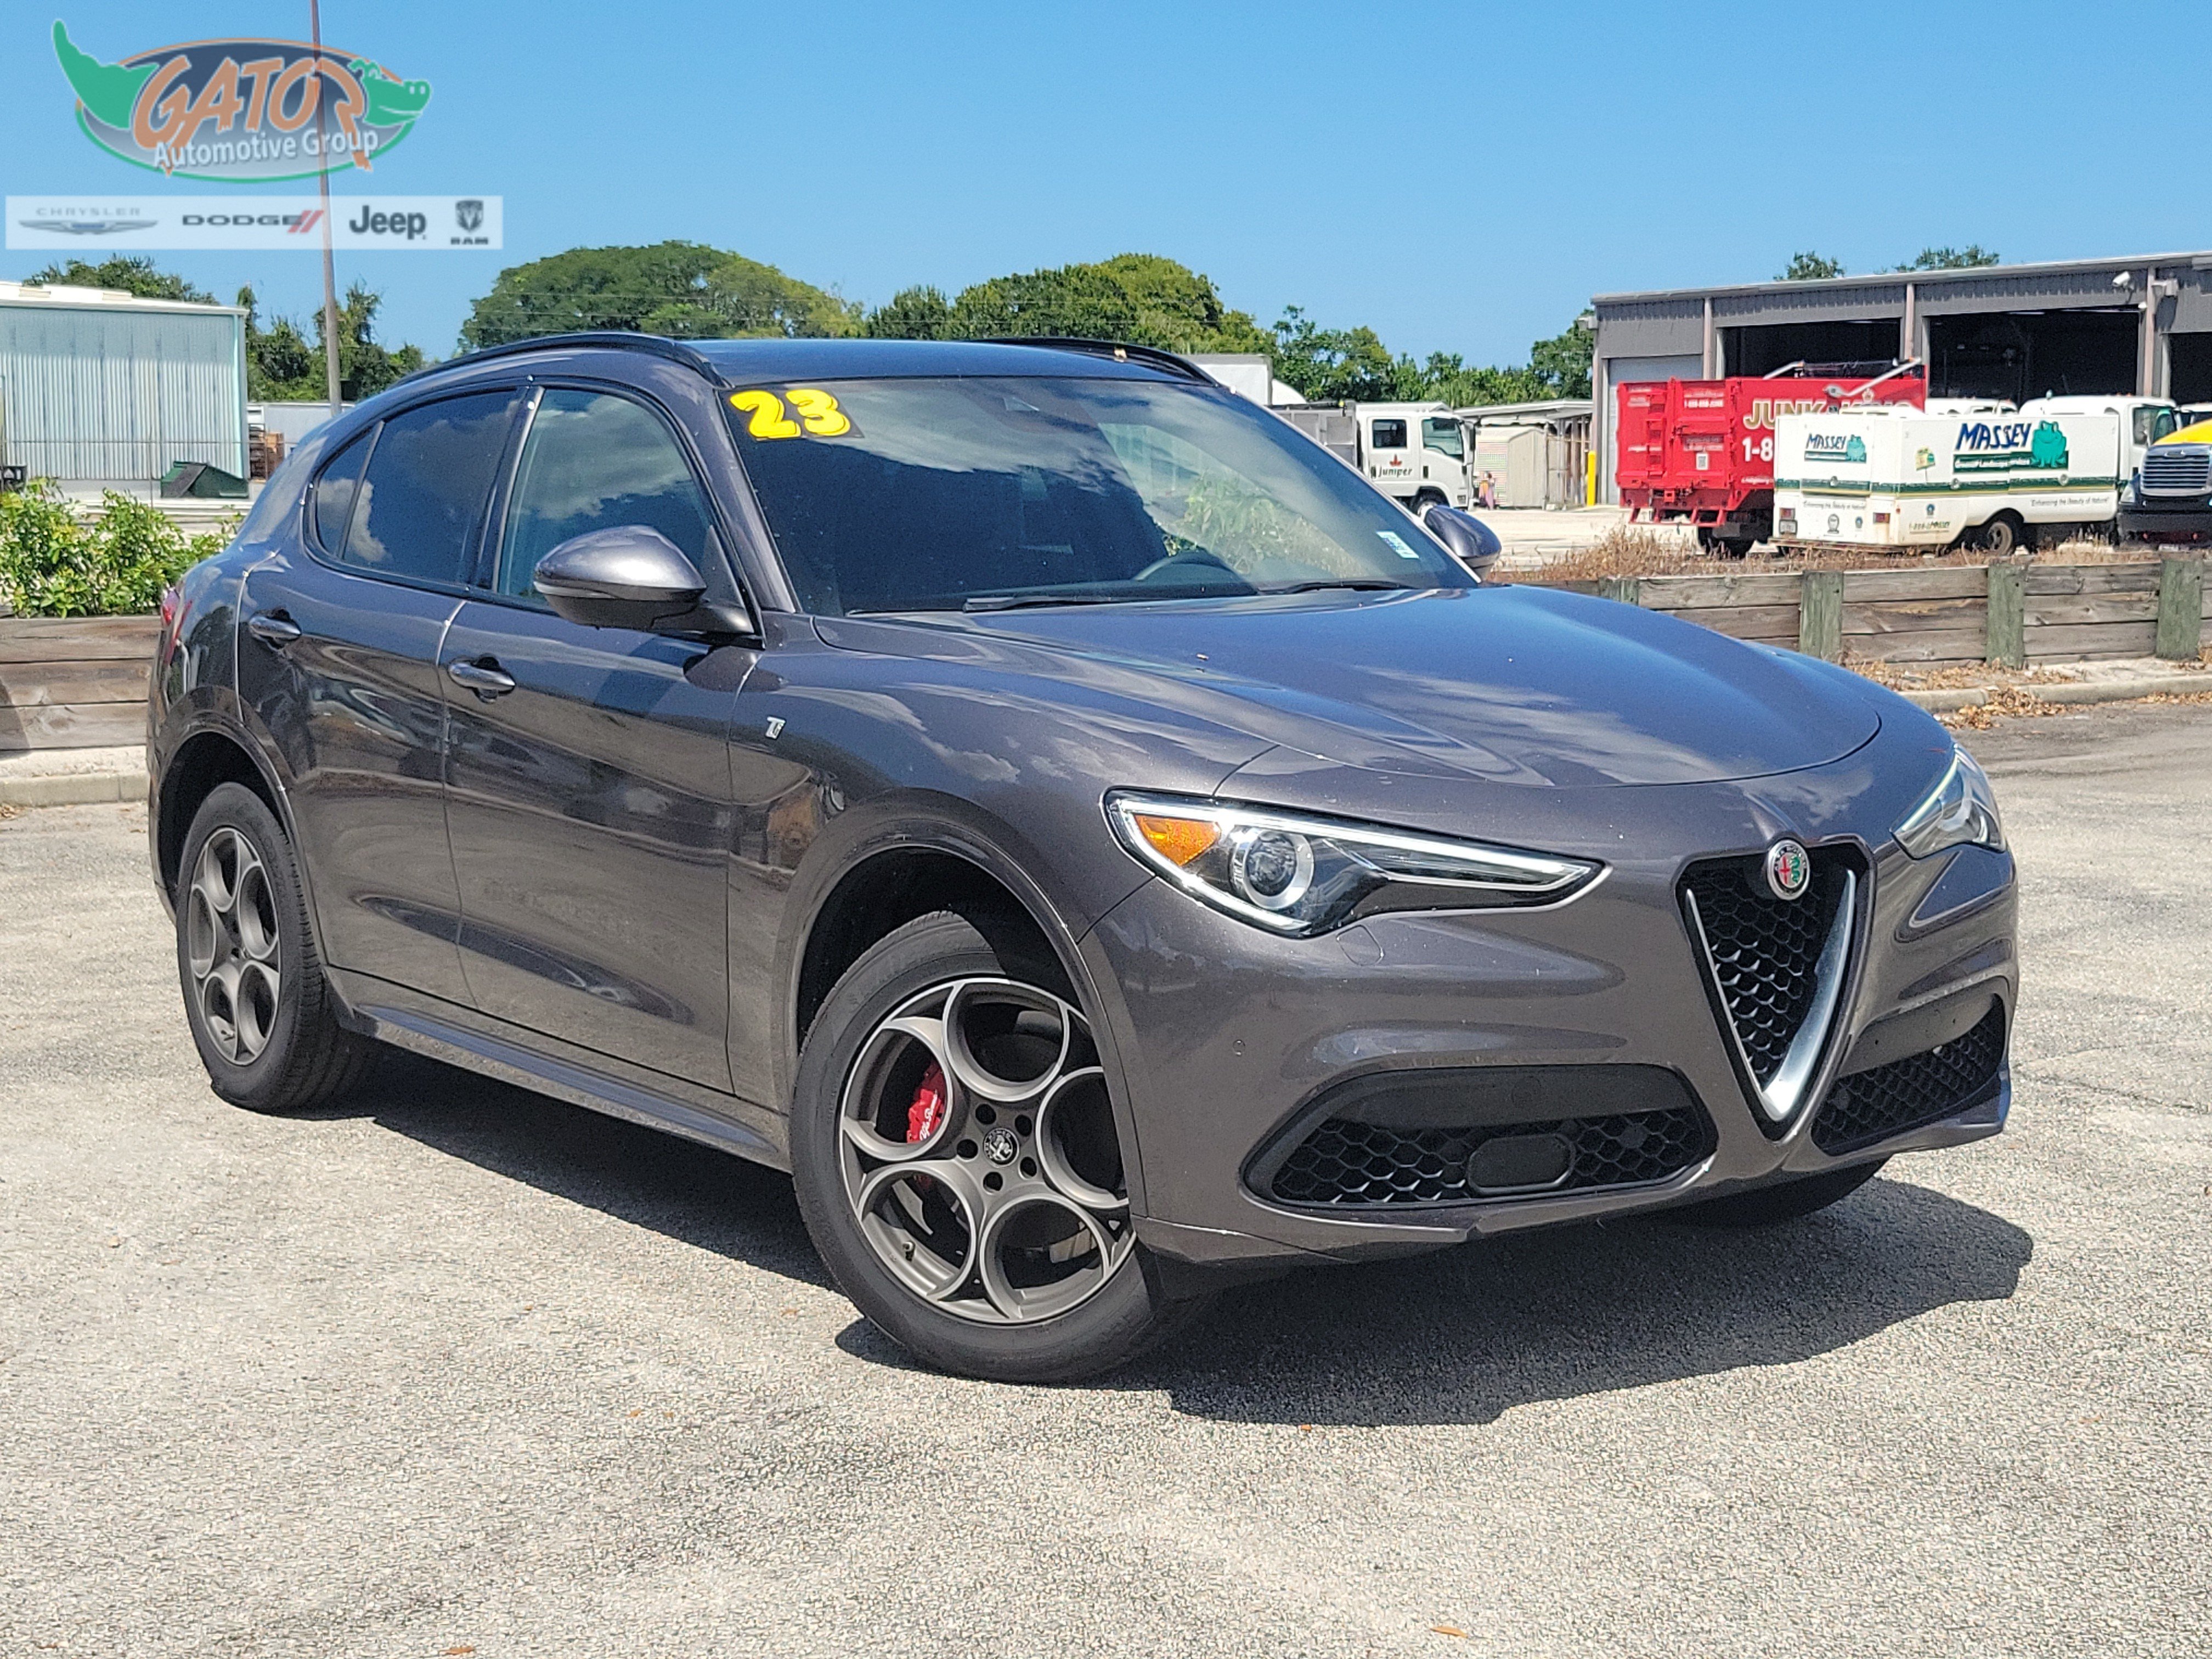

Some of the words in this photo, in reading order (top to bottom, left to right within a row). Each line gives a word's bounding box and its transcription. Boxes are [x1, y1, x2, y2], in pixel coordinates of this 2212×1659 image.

[730, 388, 850, 438] 23
[1805, 433, 1847, 449] MASSEY
[1955, 422, 2032, 450] MASSEY
